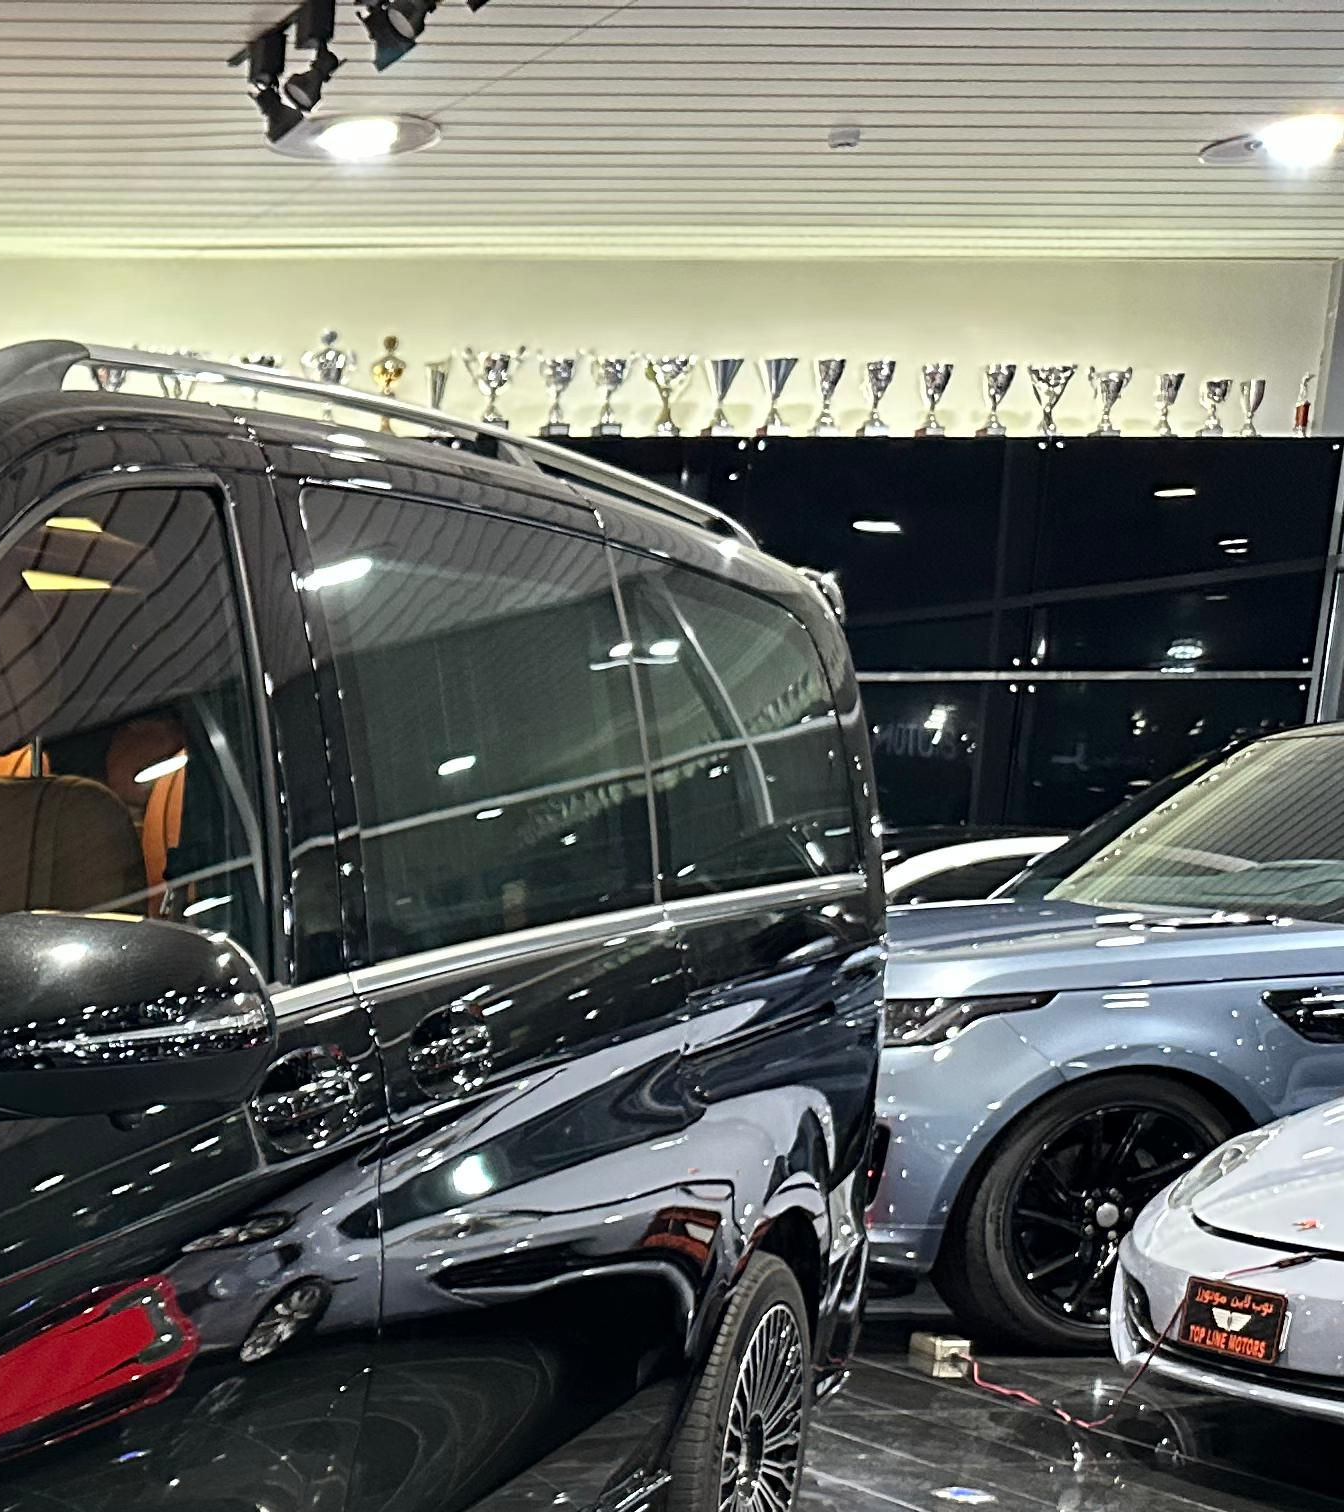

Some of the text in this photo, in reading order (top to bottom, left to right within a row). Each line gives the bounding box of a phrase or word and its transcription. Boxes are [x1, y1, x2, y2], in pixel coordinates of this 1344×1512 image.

[1189, 1325, 1267, 1359] TOP LINE MOTORS
